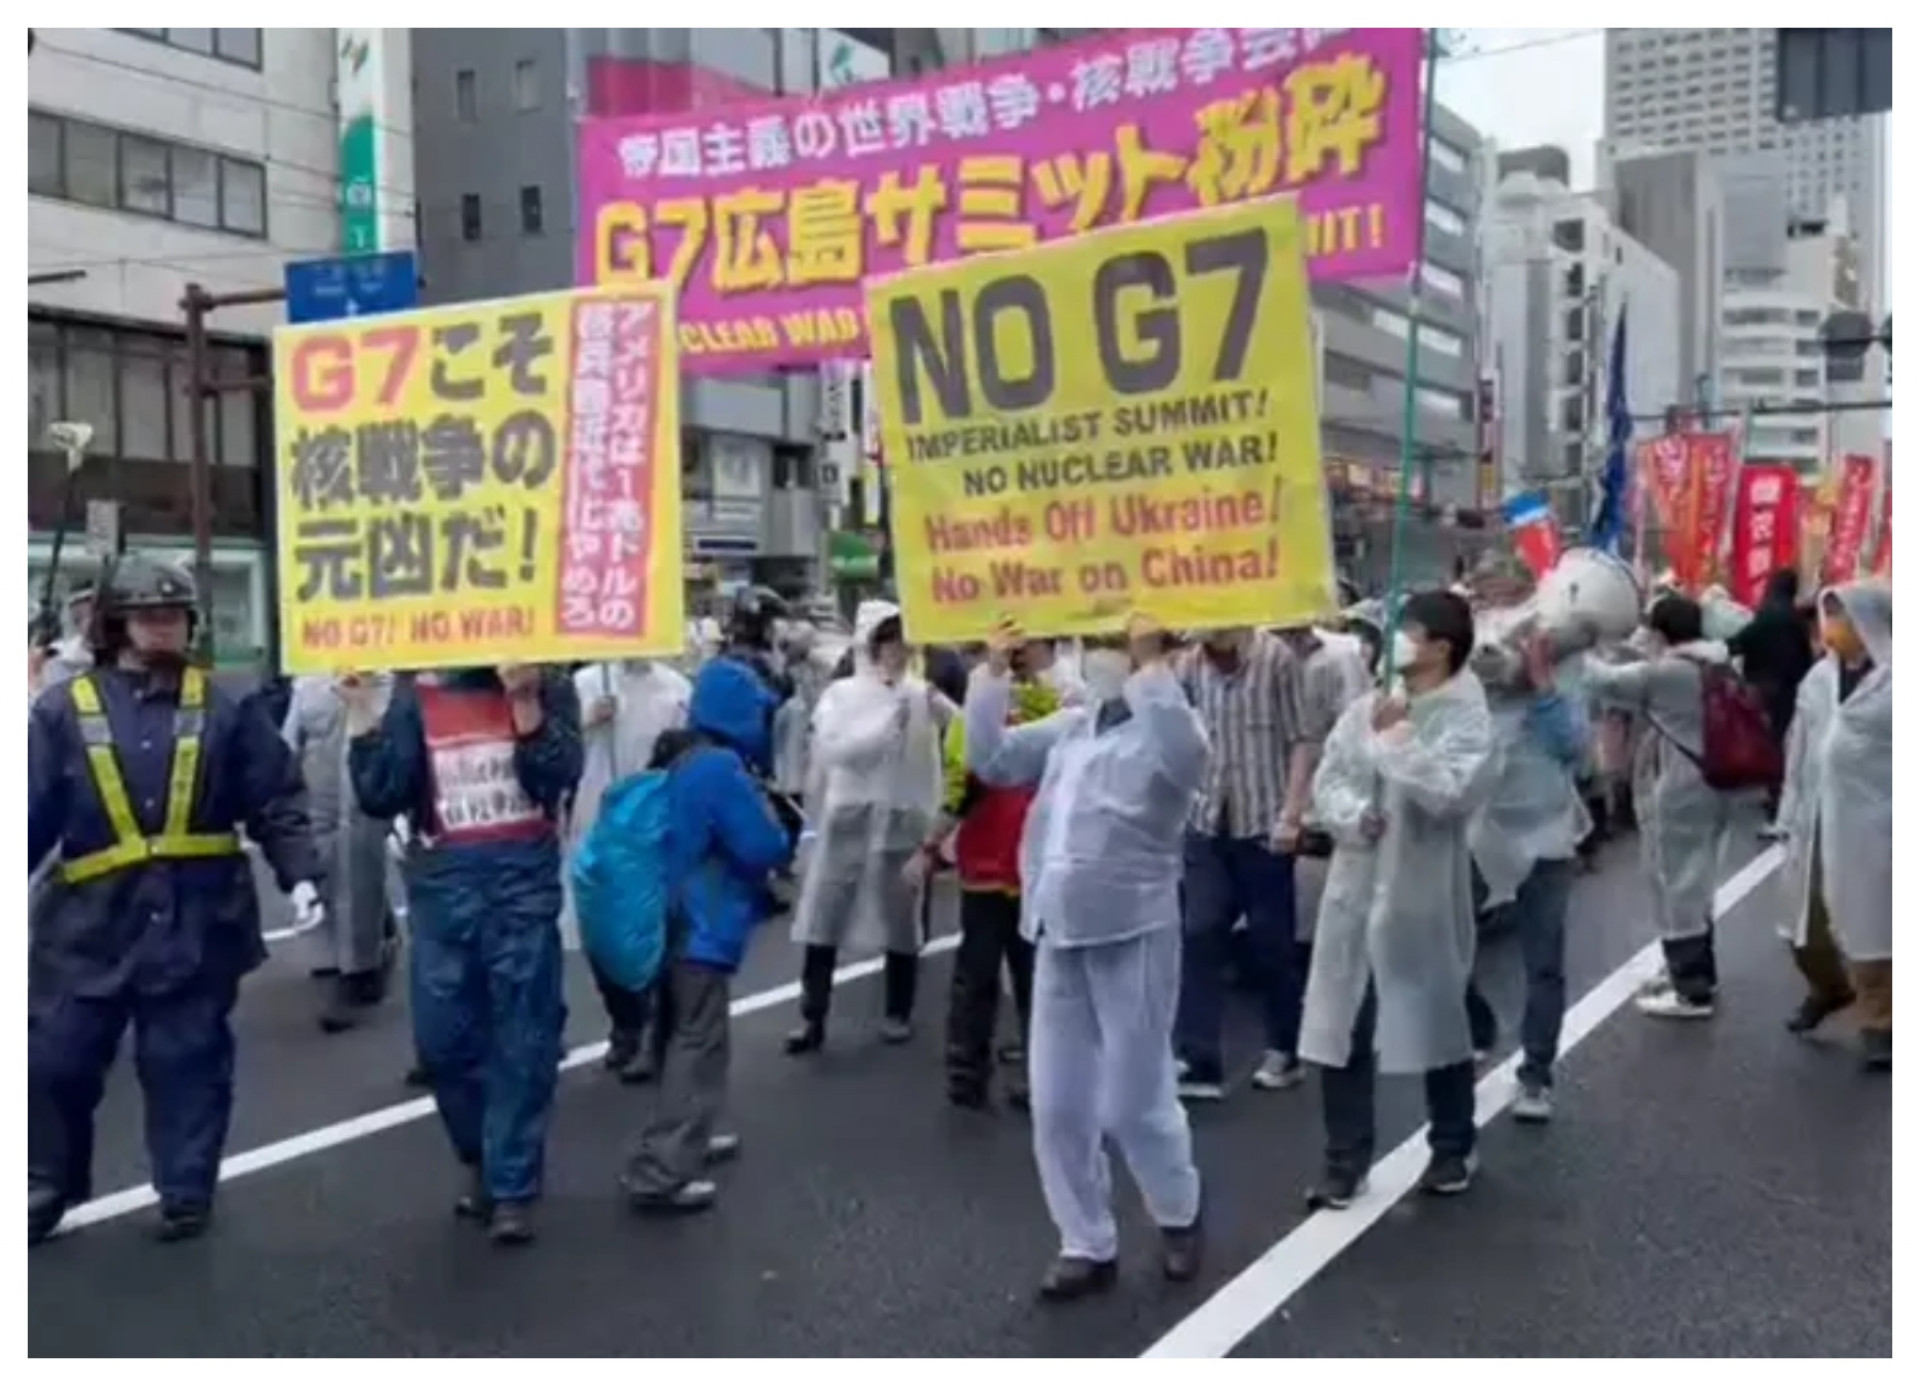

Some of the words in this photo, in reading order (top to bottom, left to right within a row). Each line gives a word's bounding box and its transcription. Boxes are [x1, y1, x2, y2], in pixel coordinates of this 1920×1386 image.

[291, 311, 554, 412] G7こそ
[889, 274, 1055, 424] NO
[1093, 227, 1268, 396] G7
[290, 410, 556, 511] 核戦争の
[906, 411, 1104, 463] IMPERIALIST
[1113, 388, 1270, 437] SUMMIT!
[963, 466, 1008, 497] NO
[1017, 445, 1175, 491] NUCLEAR
[1183, 431, 1279, 474] WAR!
[295, 505, 538, 602] 元凶だ!
[923, 507, 1033, 556] Hands
[1044, 499, 1096, 544] Off
[1110, 474, 1284, 537] Ukraine!
[931, 565, 979, 606] No
[989, 561, 1064, 599] War
[1078, 561, 1129, 594] on
[1141, 538, 1281, 588] China!
[303, 617, 341, 648] NO
[411, 610, 451, 643] NO
